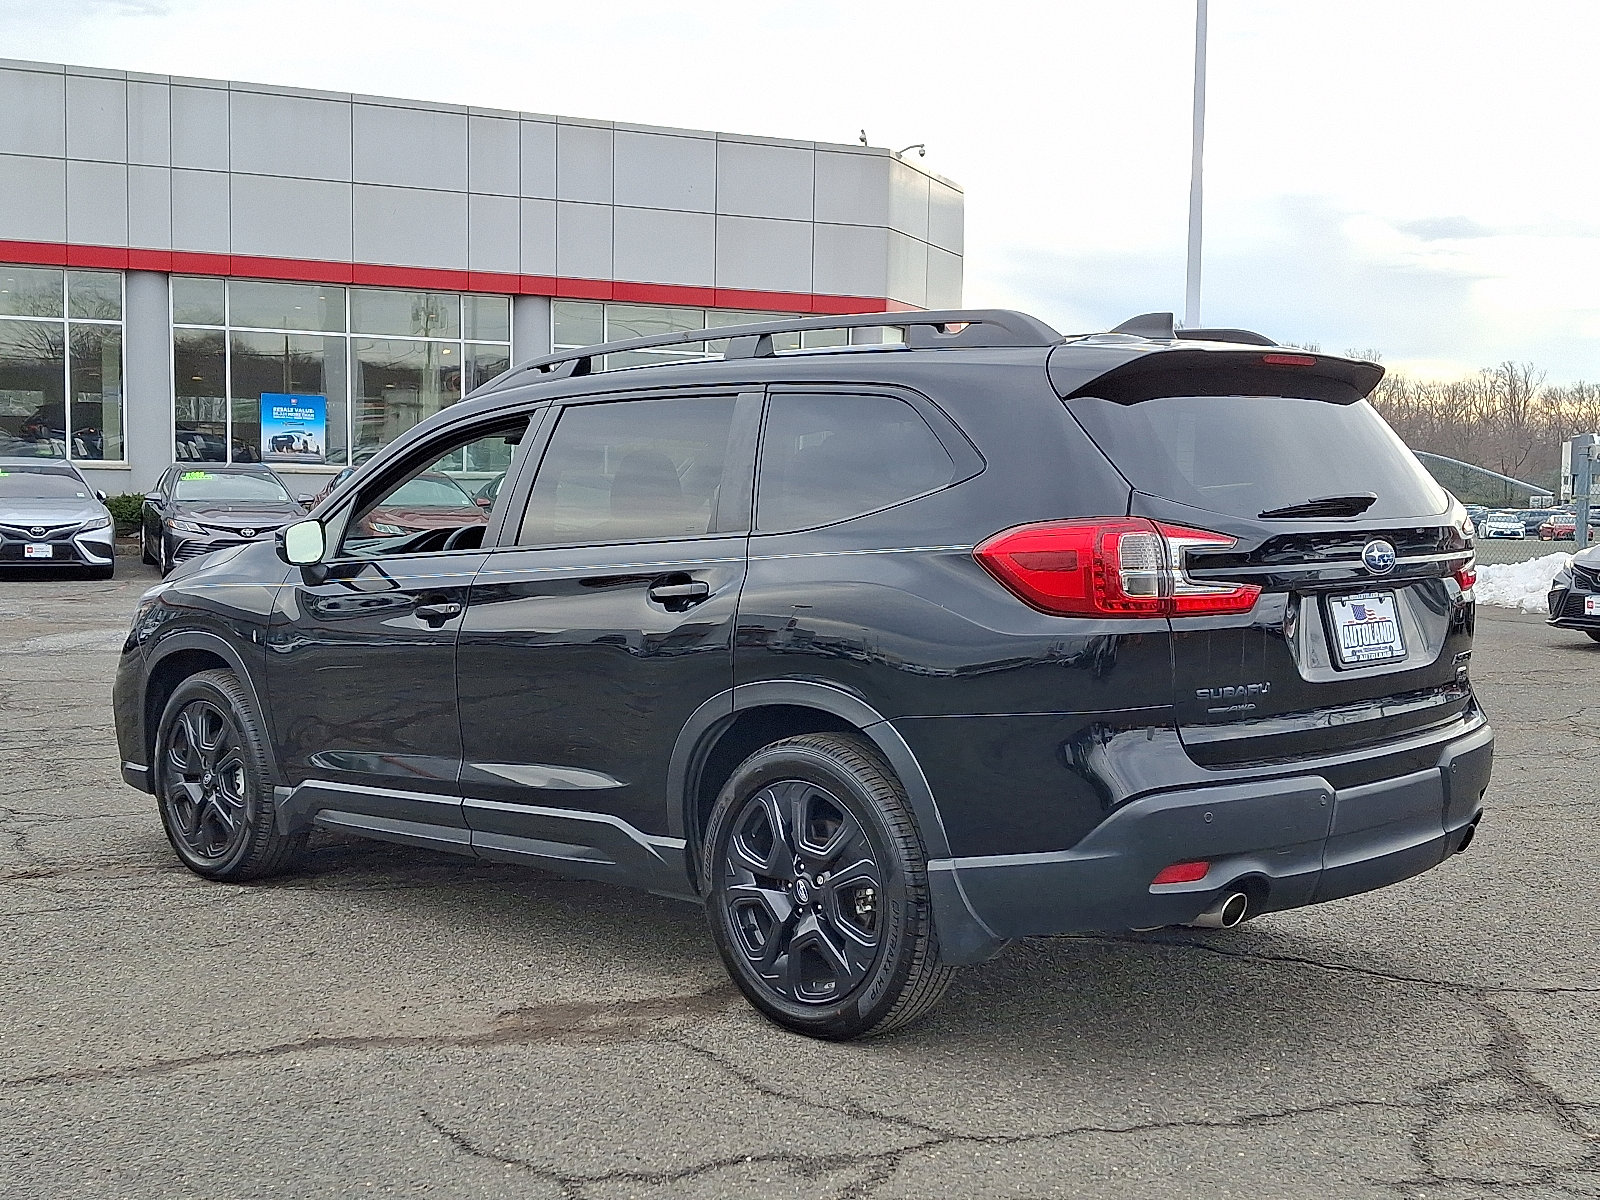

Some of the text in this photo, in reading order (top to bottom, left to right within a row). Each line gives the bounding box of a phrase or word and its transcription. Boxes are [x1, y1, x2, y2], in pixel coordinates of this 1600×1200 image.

[1343, 620, 1395, 649] AUTOLAND
[1195, 681, 1271, 699] SUBARU
[1227, 703, 1257, 712] AWD
